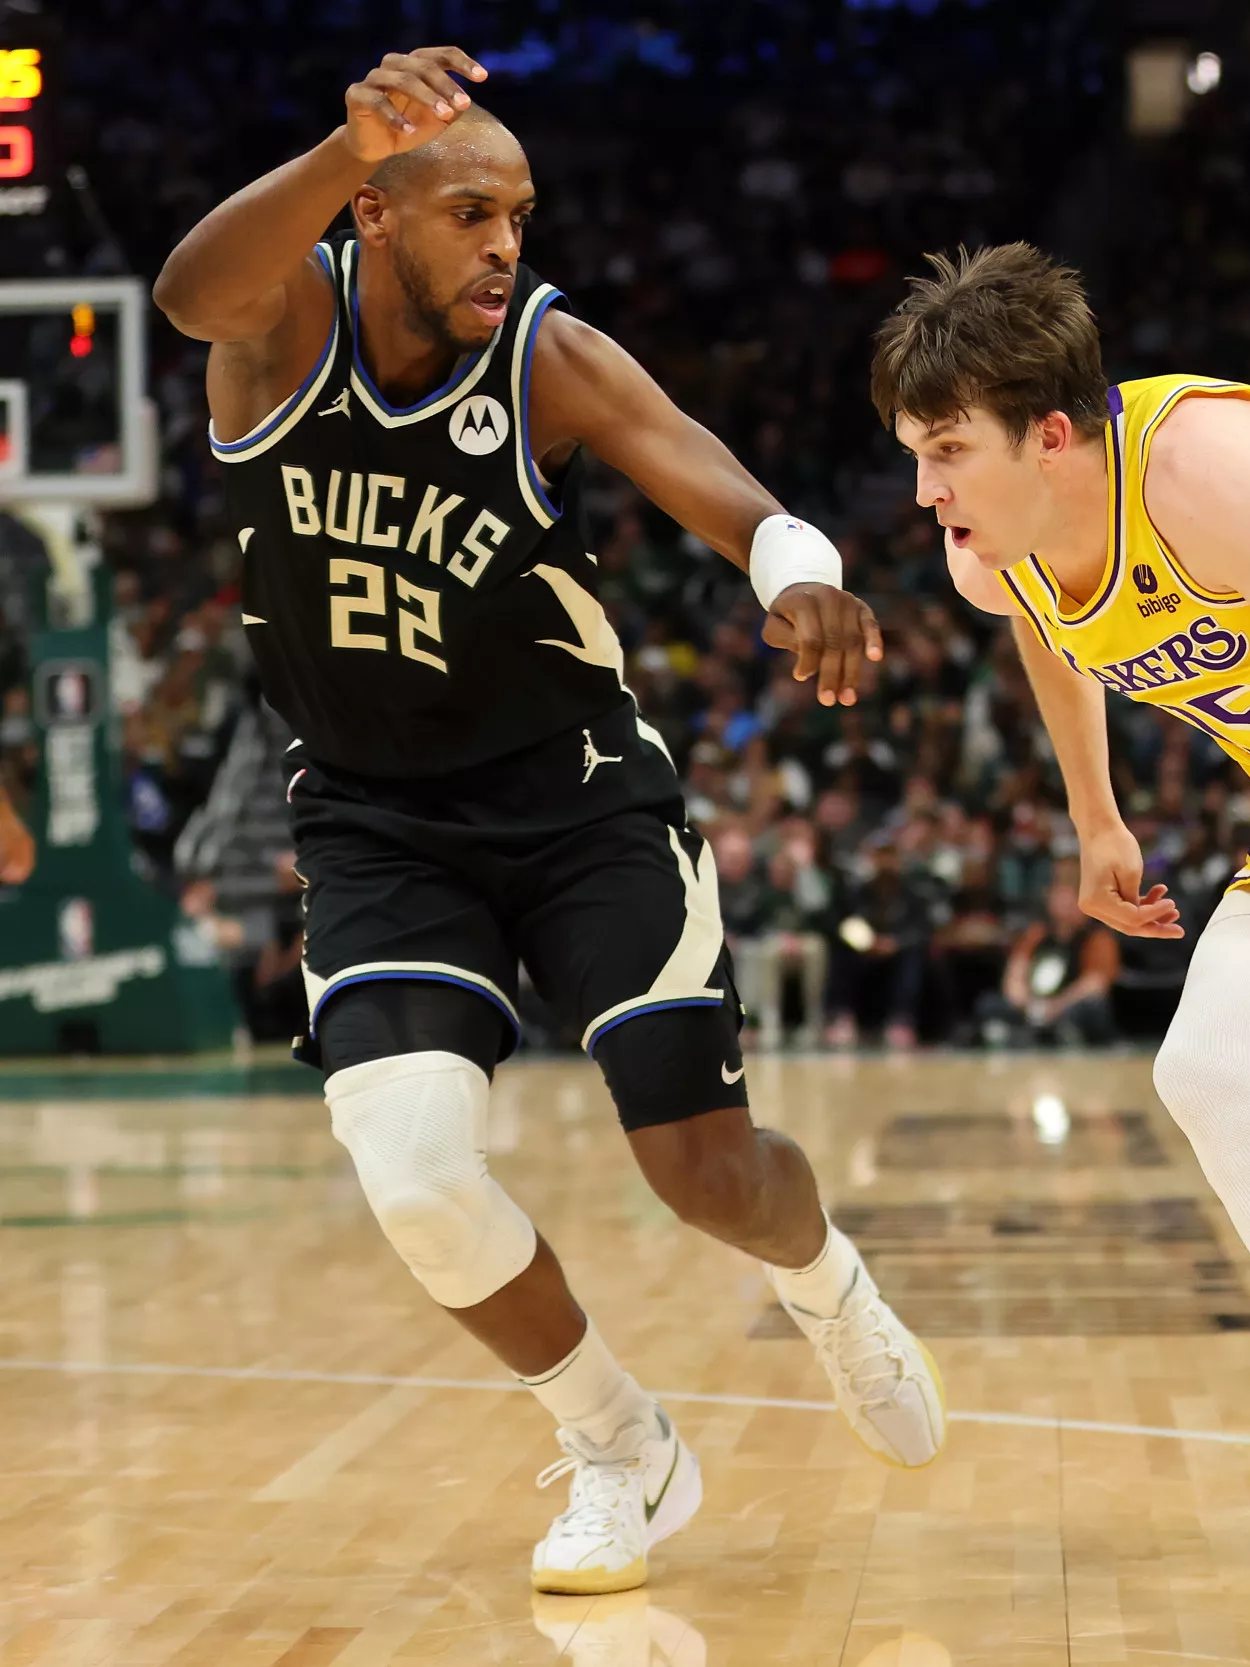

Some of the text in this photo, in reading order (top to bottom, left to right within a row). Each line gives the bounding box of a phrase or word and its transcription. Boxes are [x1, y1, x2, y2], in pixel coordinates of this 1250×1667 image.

[281, 465, 511, 588] BUCKS
[329, 558, 447, 673] 22
[1136, 593, 1181, 618] bibigo
